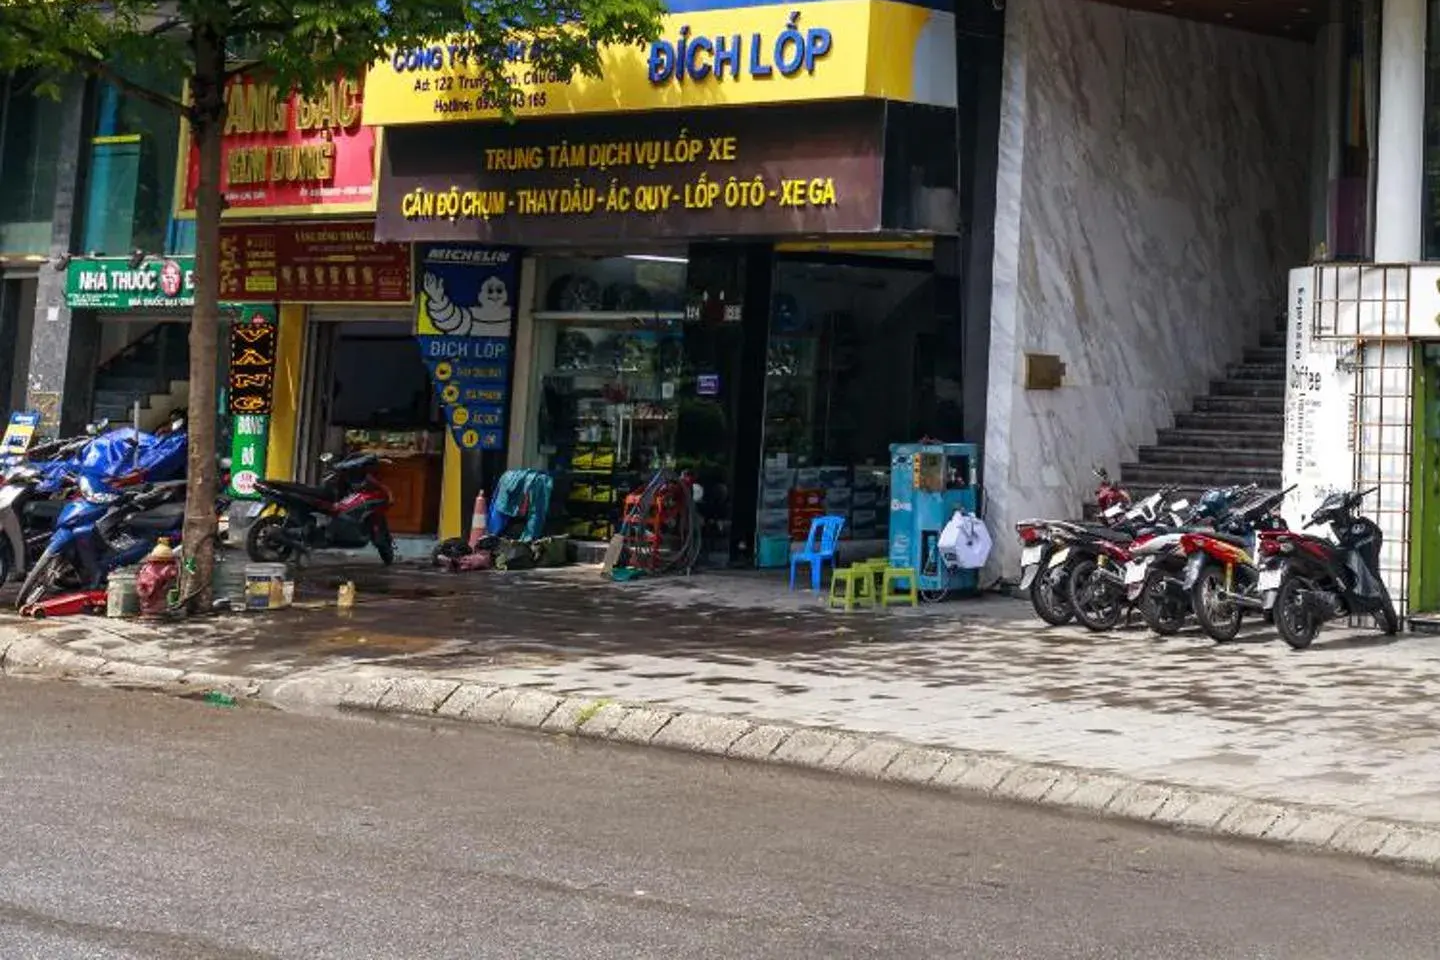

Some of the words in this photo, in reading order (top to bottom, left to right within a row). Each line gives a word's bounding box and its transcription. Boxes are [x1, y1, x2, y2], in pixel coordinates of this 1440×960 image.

[647, 26, 740, 85] ĐÍCH
[751, 11, 832, 76] LỐP
[486, 147, 543, 171] TRUNG
[548, 140, 586, 168] TÂM
[589, 141, 635, 171] DỊCH
[636, 139, 660, 170] VỤ
[664, 128, 703, 163] LỐP
[708, 137, 737, 161] XE
[516, 188, 557, 214] THAY
[560, 178, 596, 214] DẦU
[635, 183, 672, 212] QUY
[684, 171, 720, 209] LỐP
[724, 174, 765, 209] ÔTÔ
[779, 178, 807, 208] XE
[808, 176, 838, 207] GA
[111, 262, 157, 290] THUỐC
